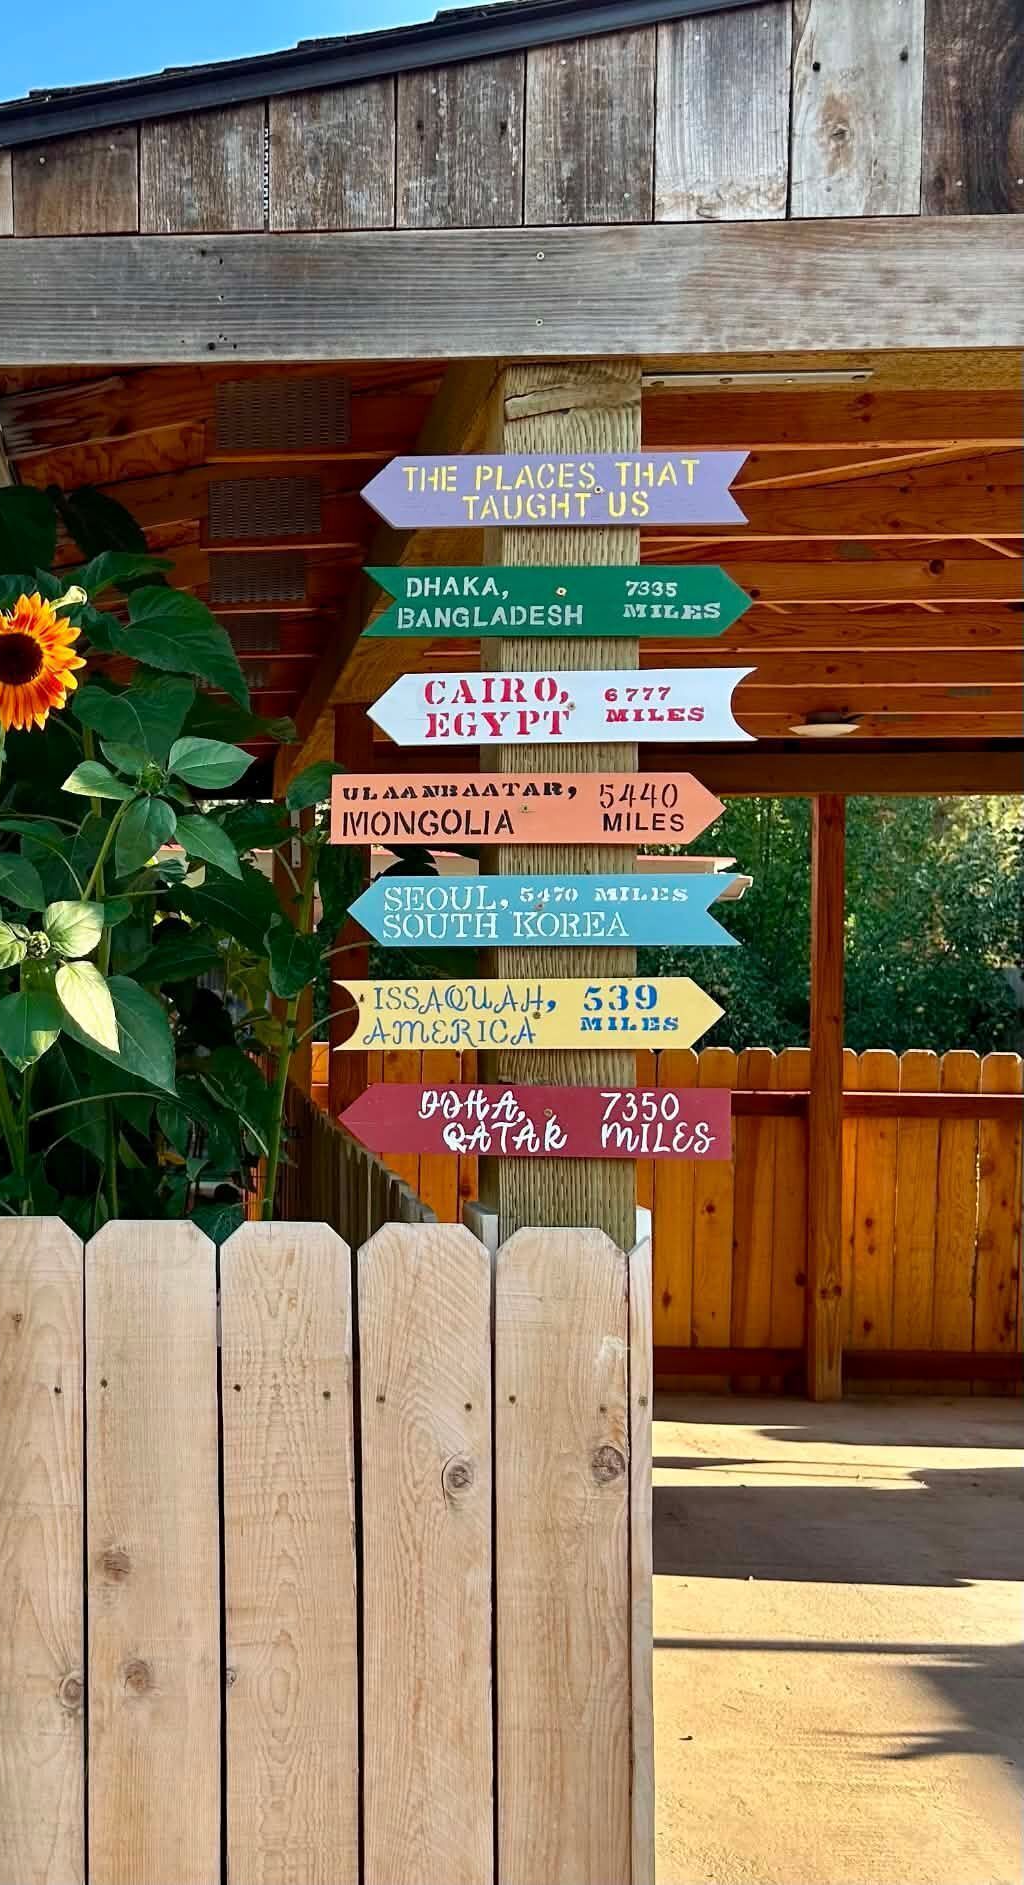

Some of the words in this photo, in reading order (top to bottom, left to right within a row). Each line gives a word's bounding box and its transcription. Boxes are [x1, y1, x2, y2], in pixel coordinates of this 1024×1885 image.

[402, 466, 458, 492] THE
[475, 462, 596, 491] PLACES
[615, 460, 700, 487] THAT
[462, 492, 592, 520] TAUGHT
[608, 491, 649, 518] US
[406, 576, 509, 600] DHAKA,
[626, 581, 677, 597] 7335
[398, 604, 583, 629] BANGLADESH
[623, 602, 720, 620] MILES
[424, 677, 570, 705] CAIRO,
[604, 687, 671, 702] 6777
[425, 711, 570, 738] EGYPT
[605, 707, 705, 723] MILES
[343, 782, 577, 800] ULAANBAATAR,
[599, 783, 678, 809] 5440
[343, 809, 515, 837] MONGOLIA
[603, 813, 685, 832] MILES
[384, 885, 508, 912] SEOUL,
[519, 887, 579, 902] 5470
[595, 886, 689, 902] MILES
[383, 912, 498, 939] SOUTH
[513, 911, 629, 937] KOREA
[373, 984, 556, 1014] ISSAQUAH,
[583, 984, 658, 1011] 539
[363, 1016, 536, 1047] AMERICA
[580, 1017, 679, 1032] MILES
[418, 1088, 525, 1122] DOHA,
[600, 1092, 680, 1121] 7350
[601, 1122, 715, 1153] MILES
